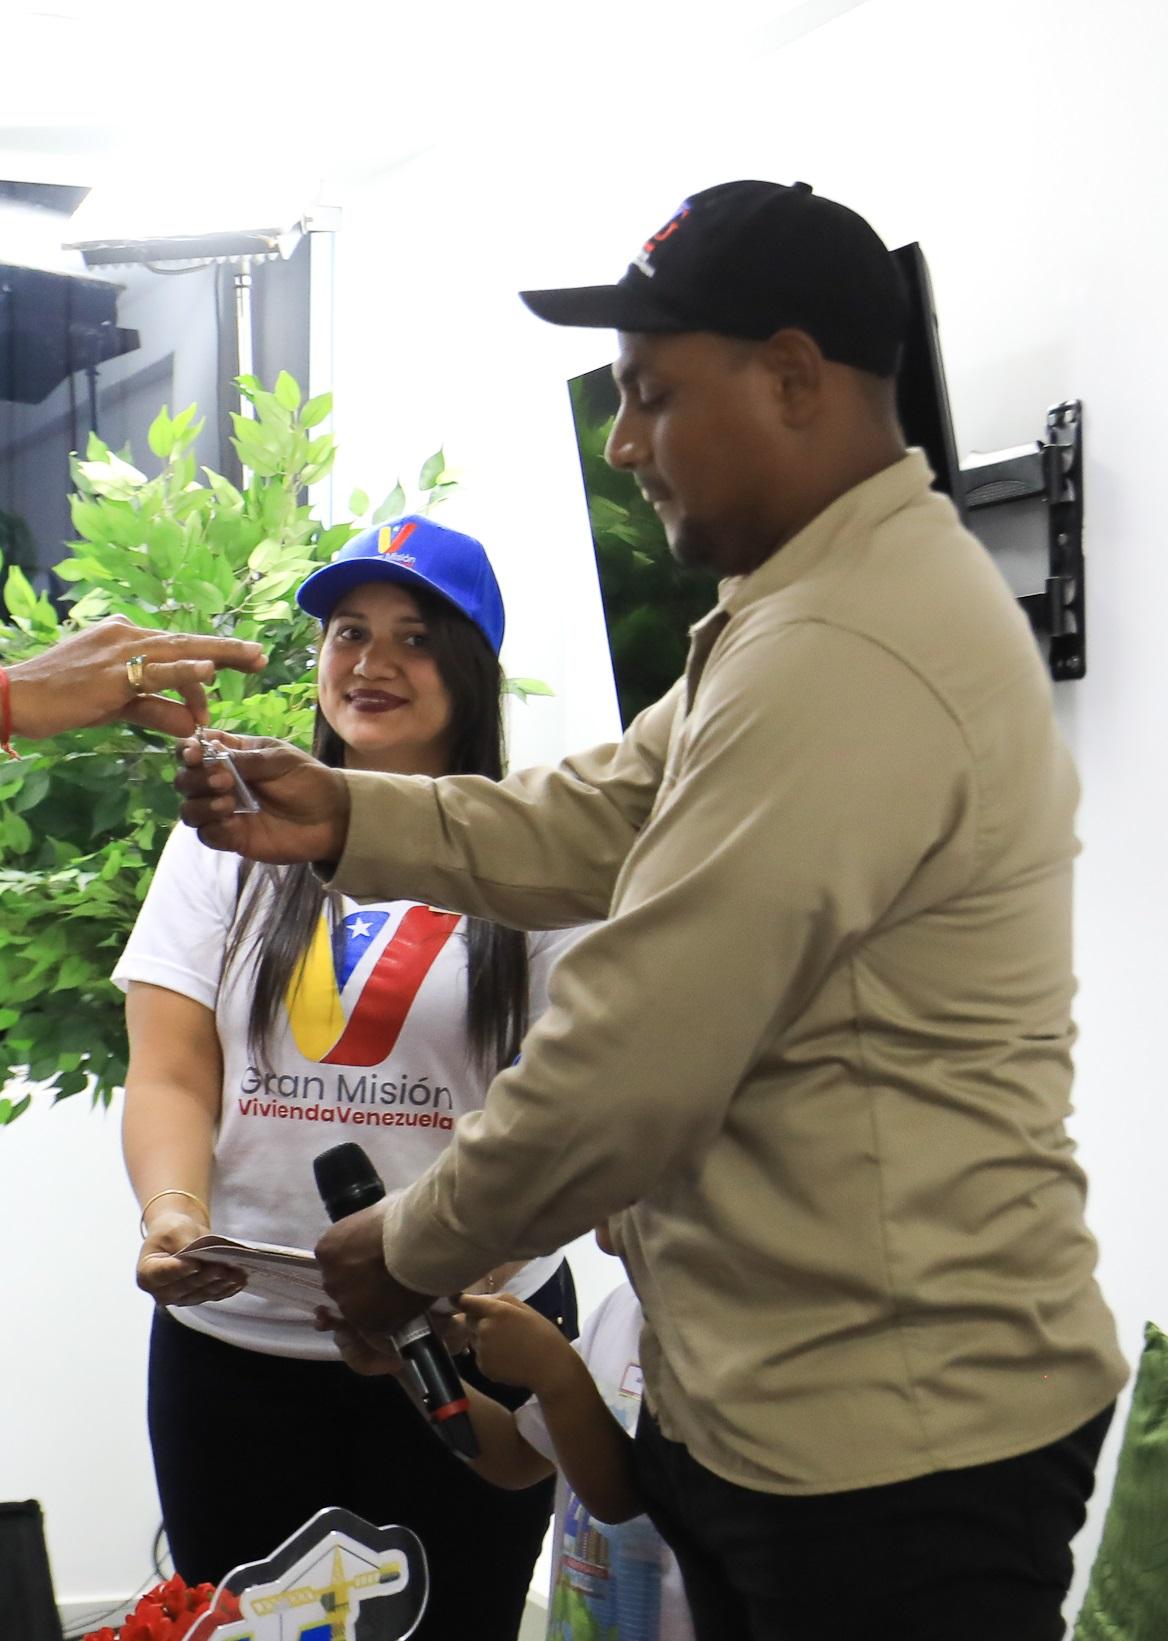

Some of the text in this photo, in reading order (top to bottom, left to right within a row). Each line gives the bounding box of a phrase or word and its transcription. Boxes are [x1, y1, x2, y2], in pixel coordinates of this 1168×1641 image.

[240, 1066, 453, 1110] Gran Misión
[238, 1098, 453, 1130] ViviendaVenezuela
